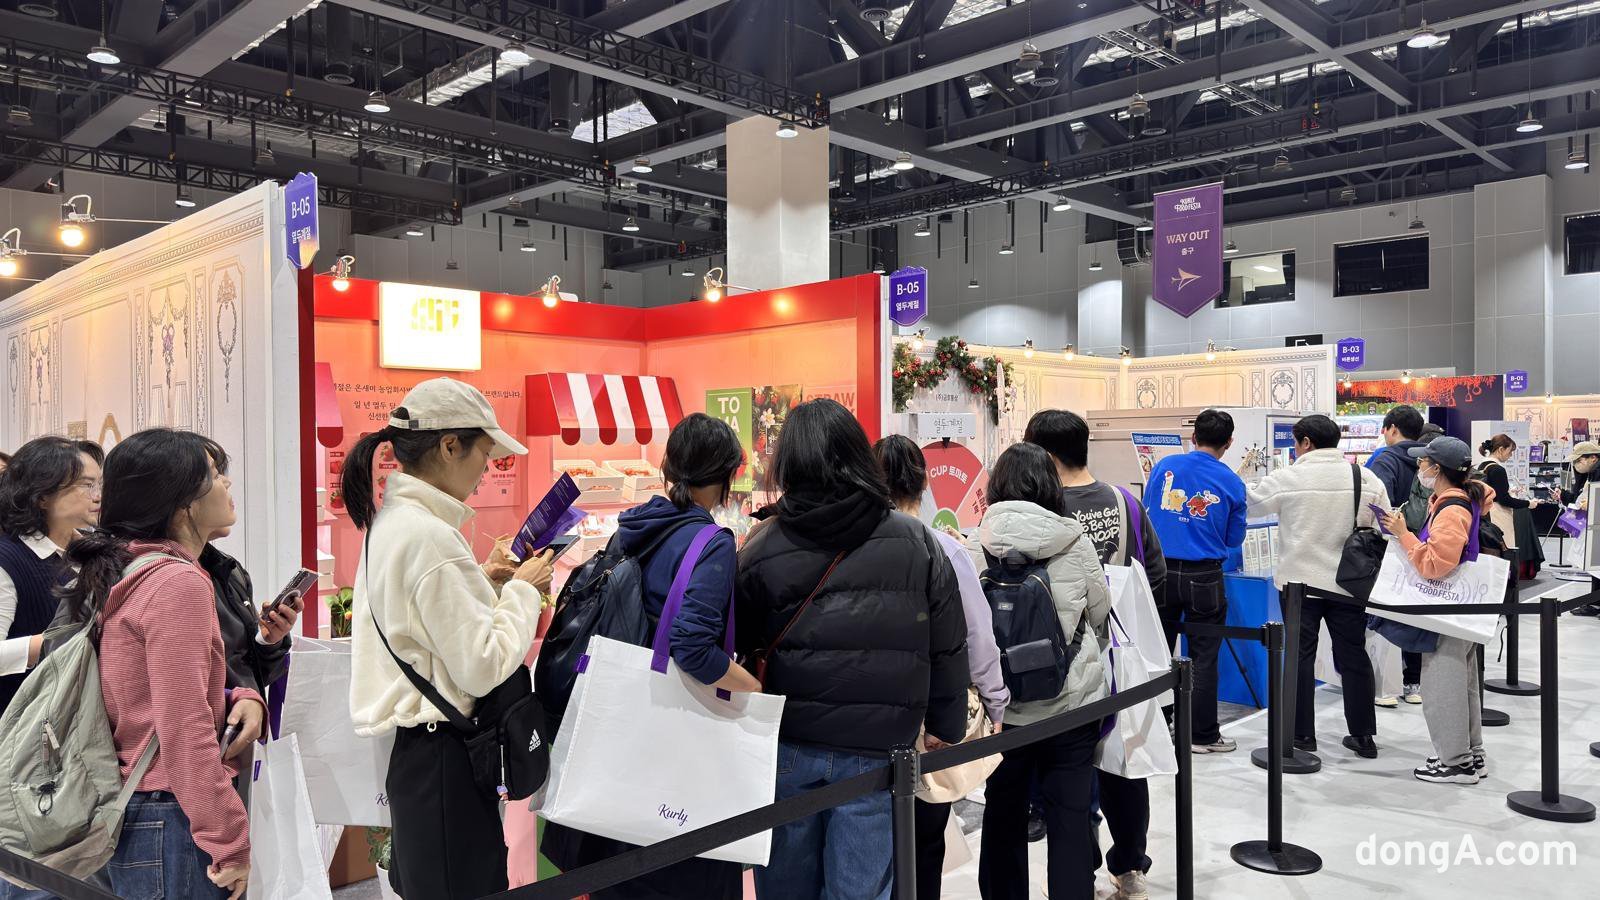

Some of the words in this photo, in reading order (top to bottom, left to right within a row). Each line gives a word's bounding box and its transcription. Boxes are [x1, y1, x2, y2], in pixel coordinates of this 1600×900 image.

[291, 196, 311, 219] B-05
[1166, 232, 1189, 245] WAY
[1189, 229, 1210, 241] OUT
[1181, 247, 1194, 256] 출구
[896, 281, 920, 296] B-05
[895, 300, 920, 312] 열두계절
[1342, 345, 1360, 354] B-03
[717, 397, 740, 414] TO
[930, 465, 948, 478] CUP
[949, 465, 969, 484] 토마토
[1089, 520, 1103, 531] Be
[1102, 517, 1119, 528] You
[1427, 578, 1453, 590] KURLY
[658, 803, 688, 827] Kurly
